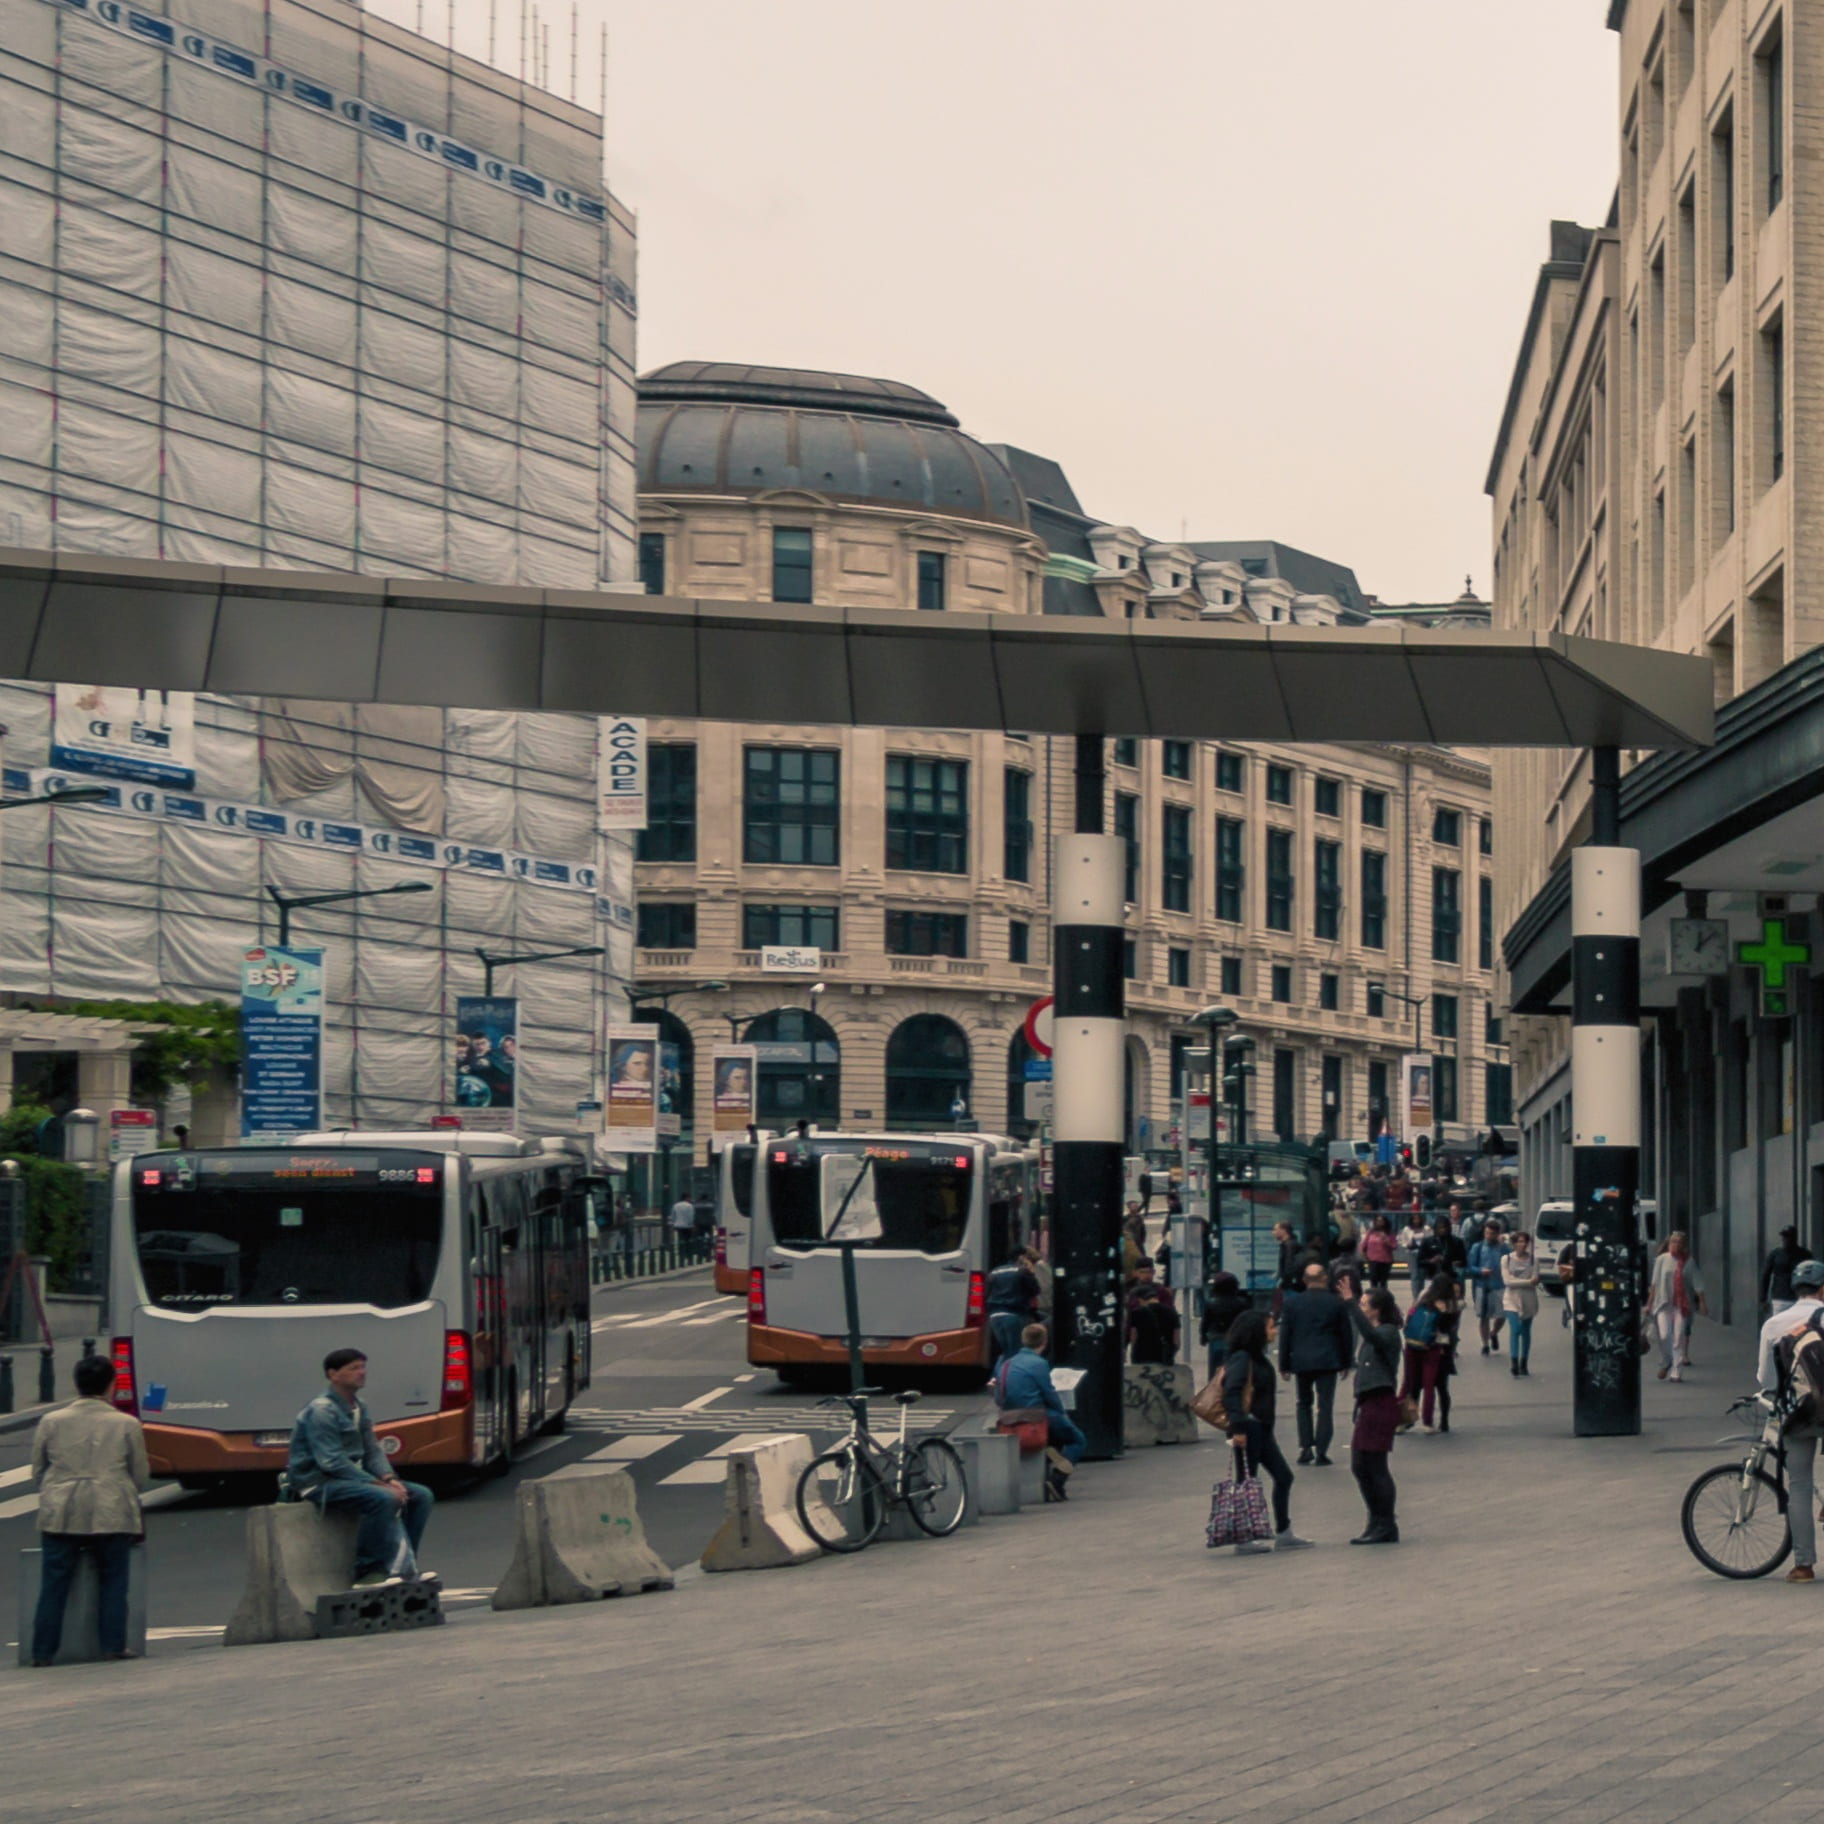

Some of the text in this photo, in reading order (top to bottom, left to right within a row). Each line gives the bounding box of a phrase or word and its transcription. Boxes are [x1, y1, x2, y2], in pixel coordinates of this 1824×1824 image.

[609, 716, 638, 790] ACADE
[766, 954, 817, 968] Regus
[247, 969, 297, 986] BSF
[379, 1169, 416, 1182] 9886
[160, 1293, 233, 1302] CITARO
